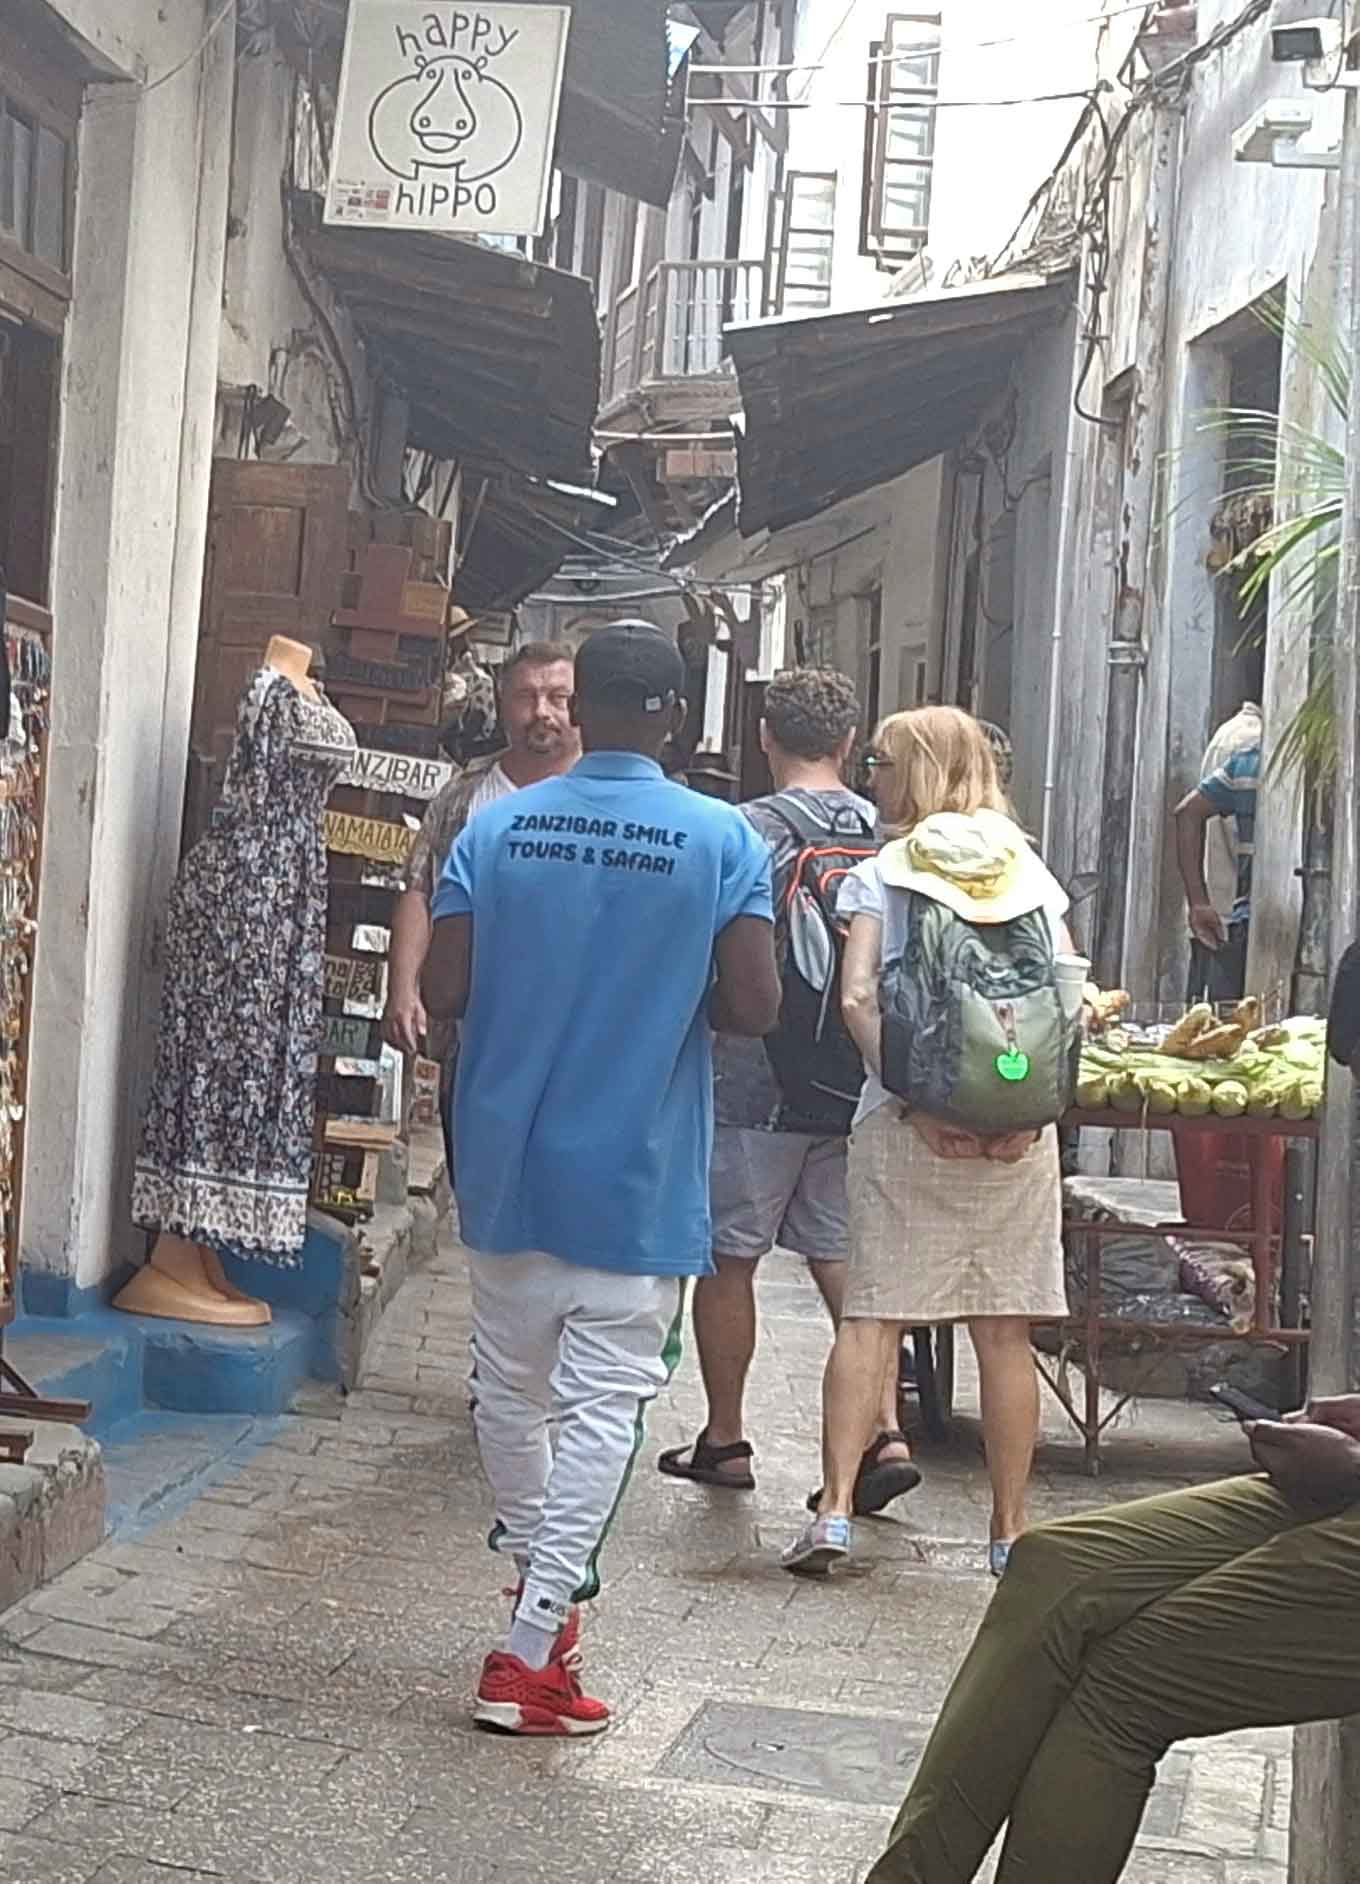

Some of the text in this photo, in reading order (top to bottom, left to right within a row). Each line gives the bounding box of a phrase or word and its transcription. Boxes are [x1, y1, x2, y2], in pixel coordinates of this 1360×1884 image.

[351, 752, 441, 790] NZIBAR
[510, 815, 688, 849] ZANZIBAR SMILE
[508, 841, 676, 876] TOURS & SAFARI
